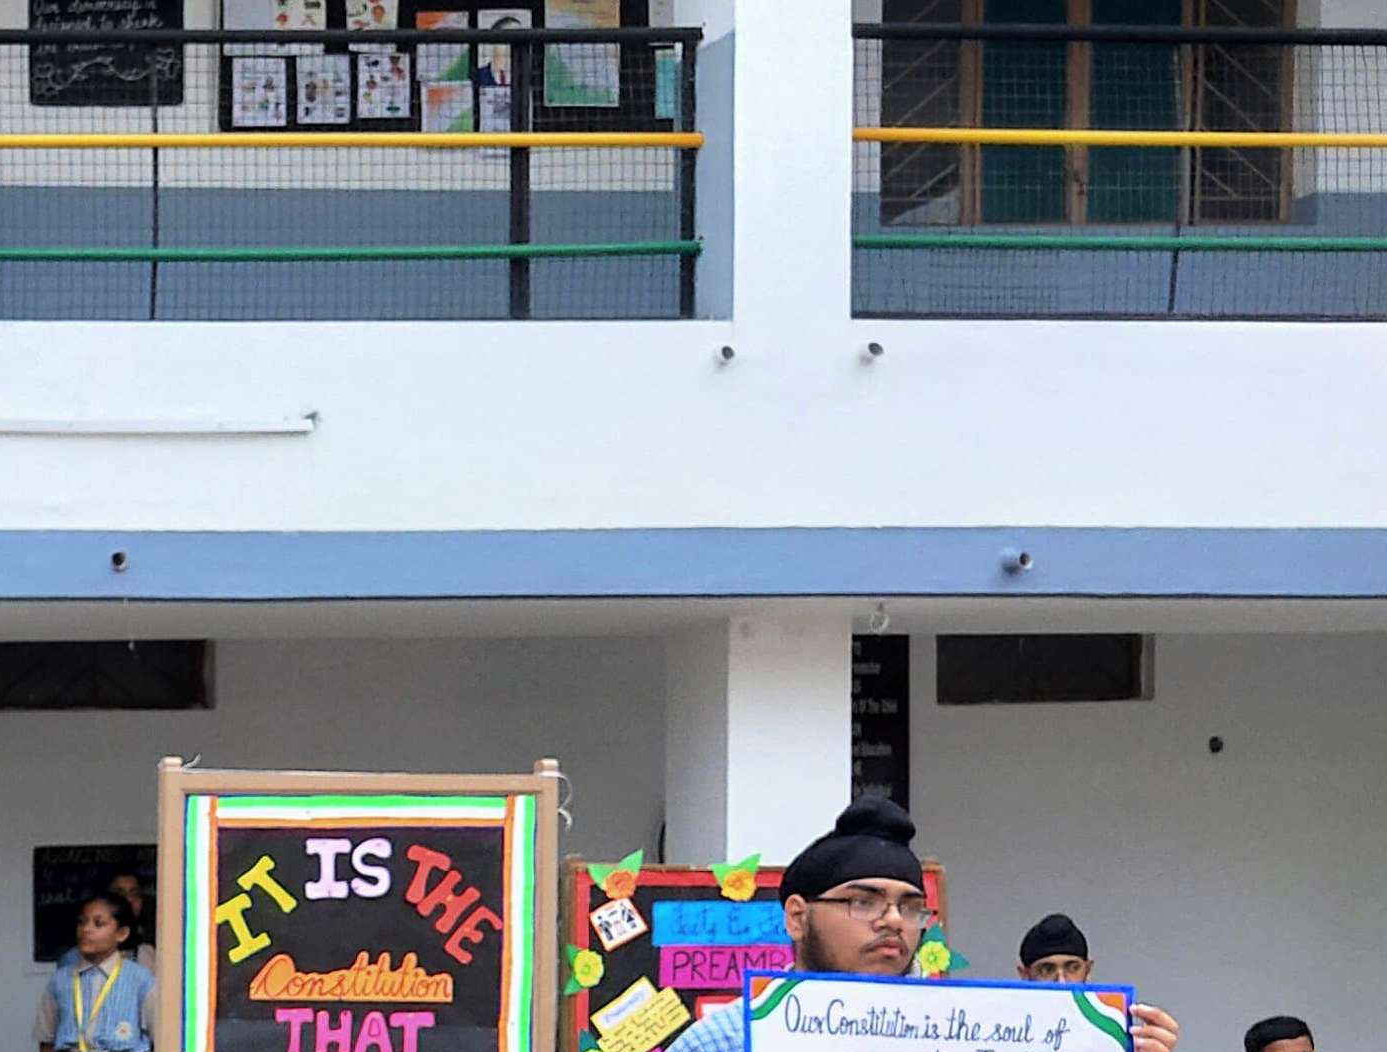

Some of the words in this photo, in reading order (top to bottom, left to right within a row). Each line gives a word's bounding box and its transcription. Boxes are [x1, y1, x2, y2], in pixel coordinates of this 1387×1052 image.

[215, 855, 297, 964] IT
[305, 837, 393, 900] IS
[404, 843, 504, 966] THE
[252, 952, 453, 1000] Constitution
[671, 950, 789, 983] PREAMB
[784, 993, 824, 1035] Our
[825, 999, 920, 1040] Constitution
[924, 1014, 940, 1041] is
[943, 1009, 981, 1044] the
[983, 1015, 1034, 1044] soul
[1043, 1016, 1071, 1051] of
